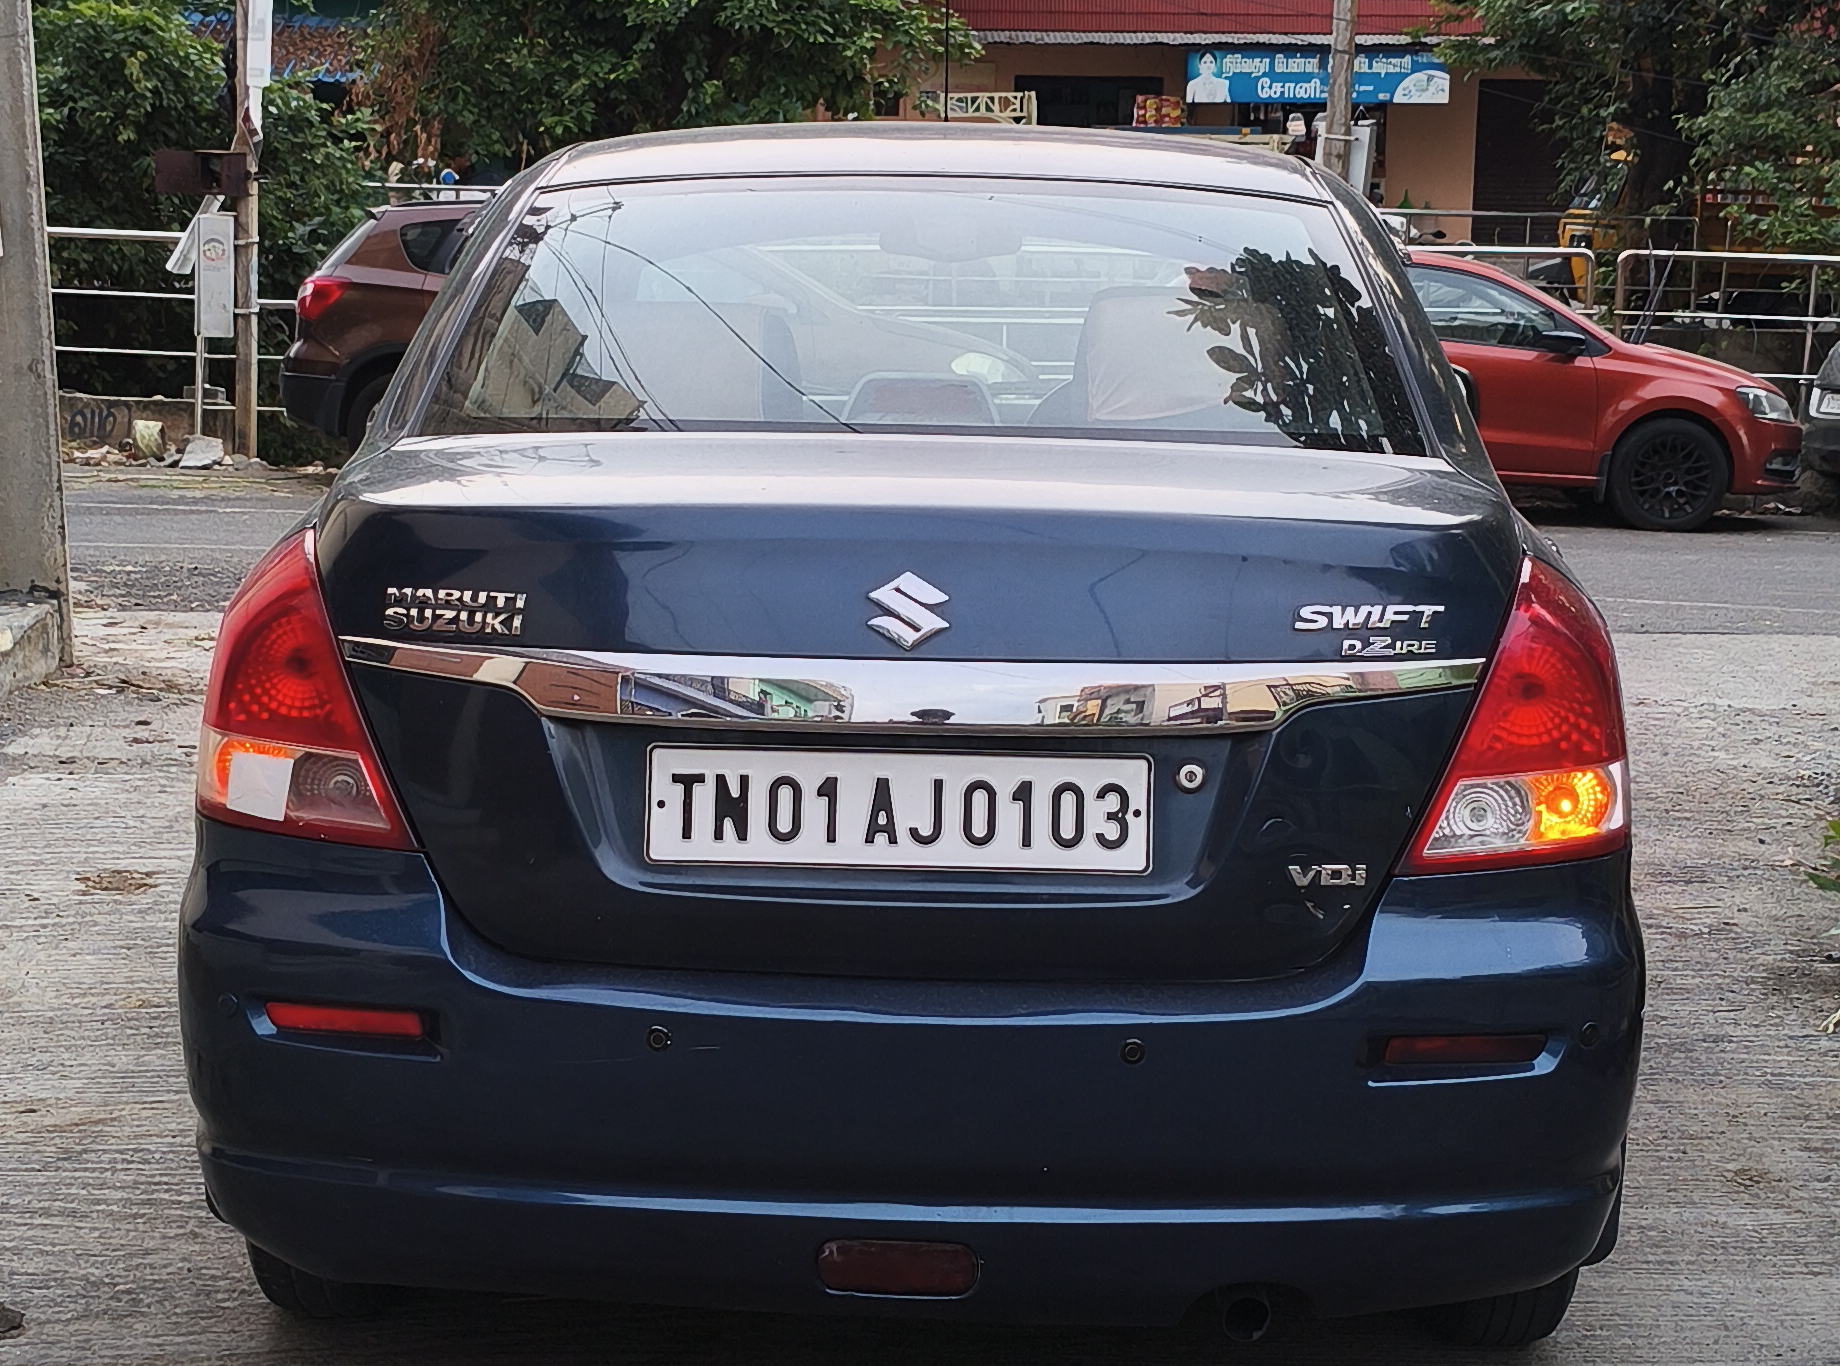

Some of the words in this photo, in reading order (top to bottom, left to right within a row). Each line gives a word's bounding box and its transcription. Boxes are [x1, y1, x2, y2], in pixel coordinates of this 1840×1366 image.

[385, 587, 527, 609] MARUTI
[383, 606, 523, 635] SUZUKI
[1294, 604, 1446, 630] SWIFT
[1341, 636, 1438, 657] DZIRE
[1287, 864, 1367, 887] VDi
